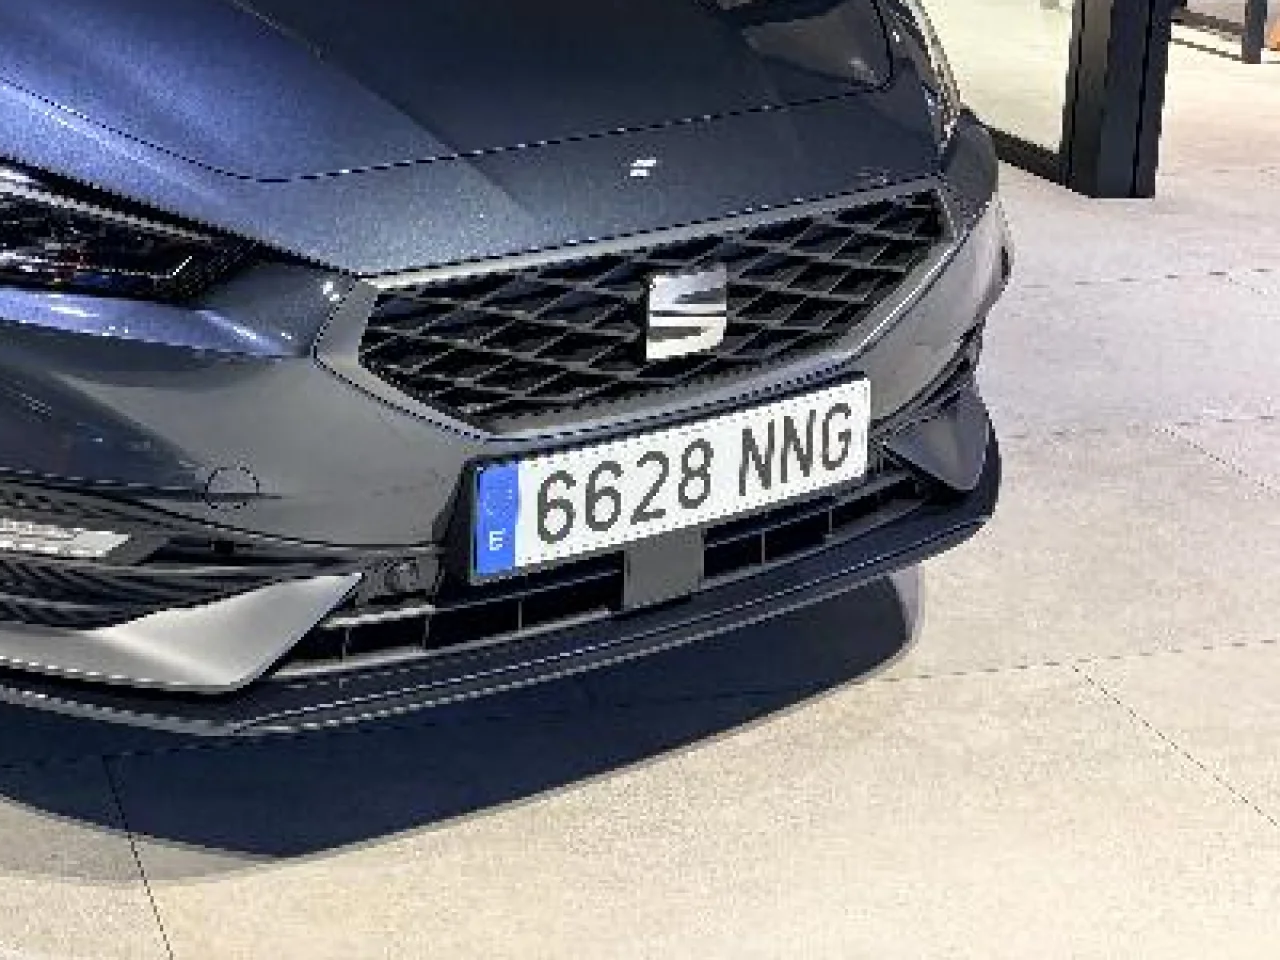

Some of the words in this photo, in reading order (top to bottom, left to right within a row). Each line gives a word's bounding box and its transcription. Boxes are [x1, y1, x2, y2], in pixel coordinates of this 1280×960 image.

[537, 438, 714, 544] 6628
[739, 402, 852, 496] NNG
[488, 528, 507, 552] E
